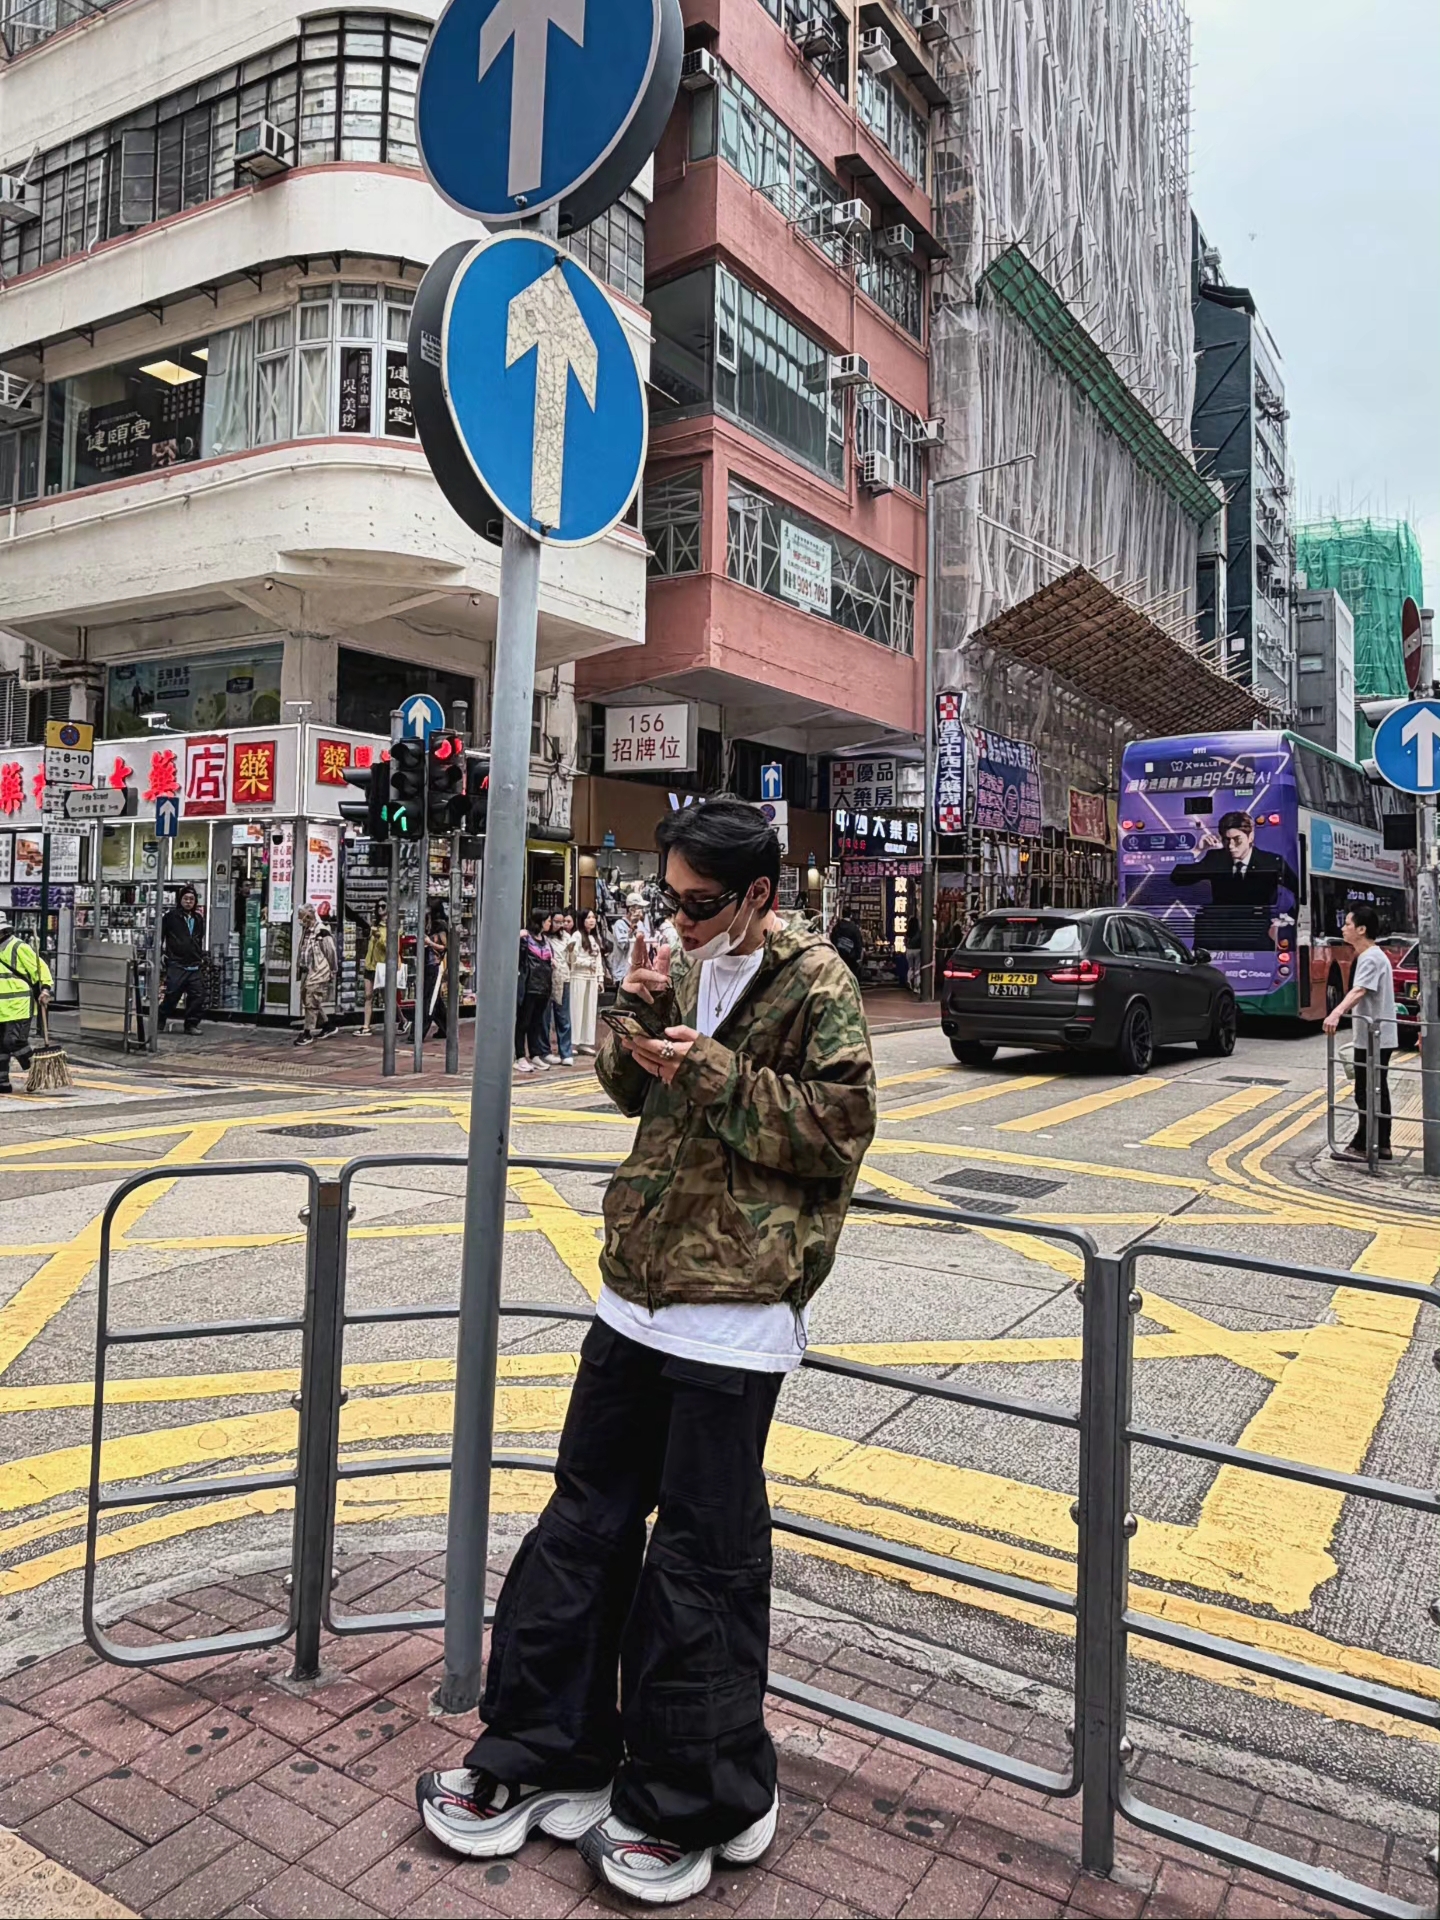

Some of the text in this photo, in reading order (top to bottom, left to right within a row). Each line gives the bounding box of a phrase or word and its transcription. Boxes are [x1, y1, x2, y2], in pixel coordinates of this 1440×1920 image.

[628, 713, 665, 733] 156
[63, 753, 91, 765] 8-10
[612, 735, 681, 763] 招牌位
[186, 745, 227, 801] 店
[237, 748, 271, 795] 藥
[321, 744, 349, 779] 藥
[856, 761, 894, 783] 優品
[938, 718, 962, 806] 優品中西大藥房
[63, 770, 86, 780] 5-7
[833, 785, 894, 808] 大藥房
[1007, 974, 1035, 984] 2738
